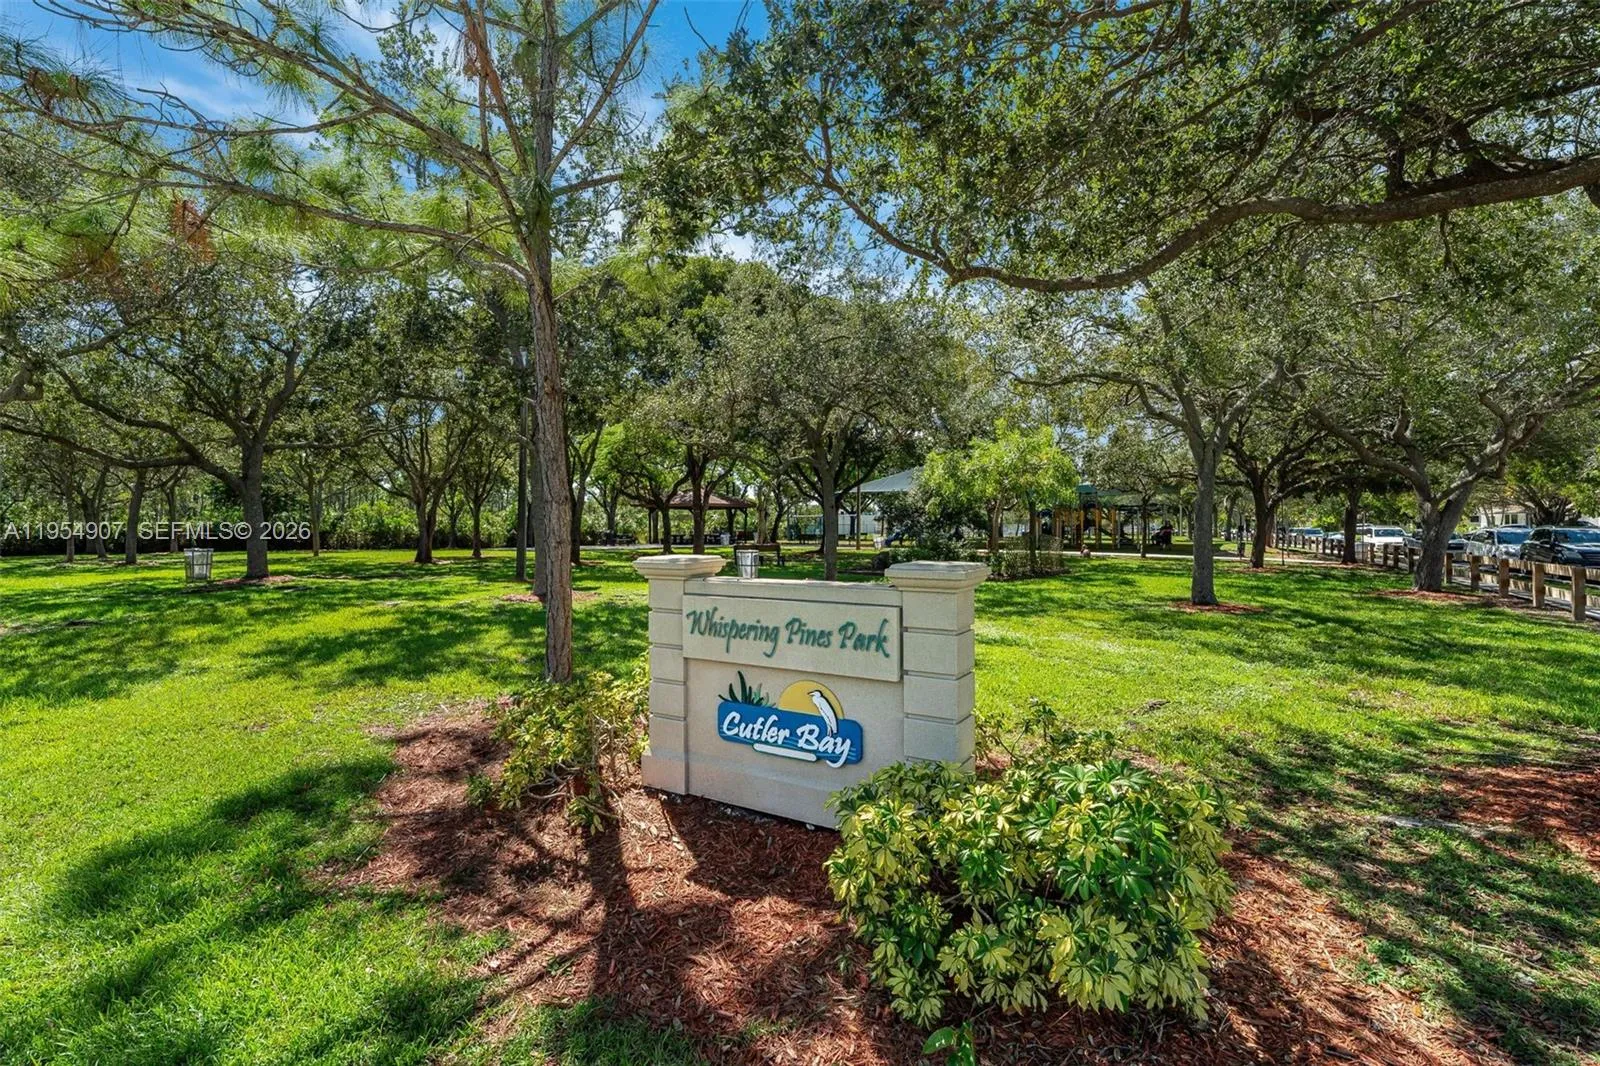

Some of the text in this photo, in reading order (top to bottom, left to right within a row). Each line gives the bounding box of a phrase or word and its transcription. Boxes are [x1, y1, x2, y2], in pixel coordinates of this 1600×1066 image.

[686, 606, 891, 658] Whispering Pines Park
[722, 711, 851, 769] Cutler Bay
